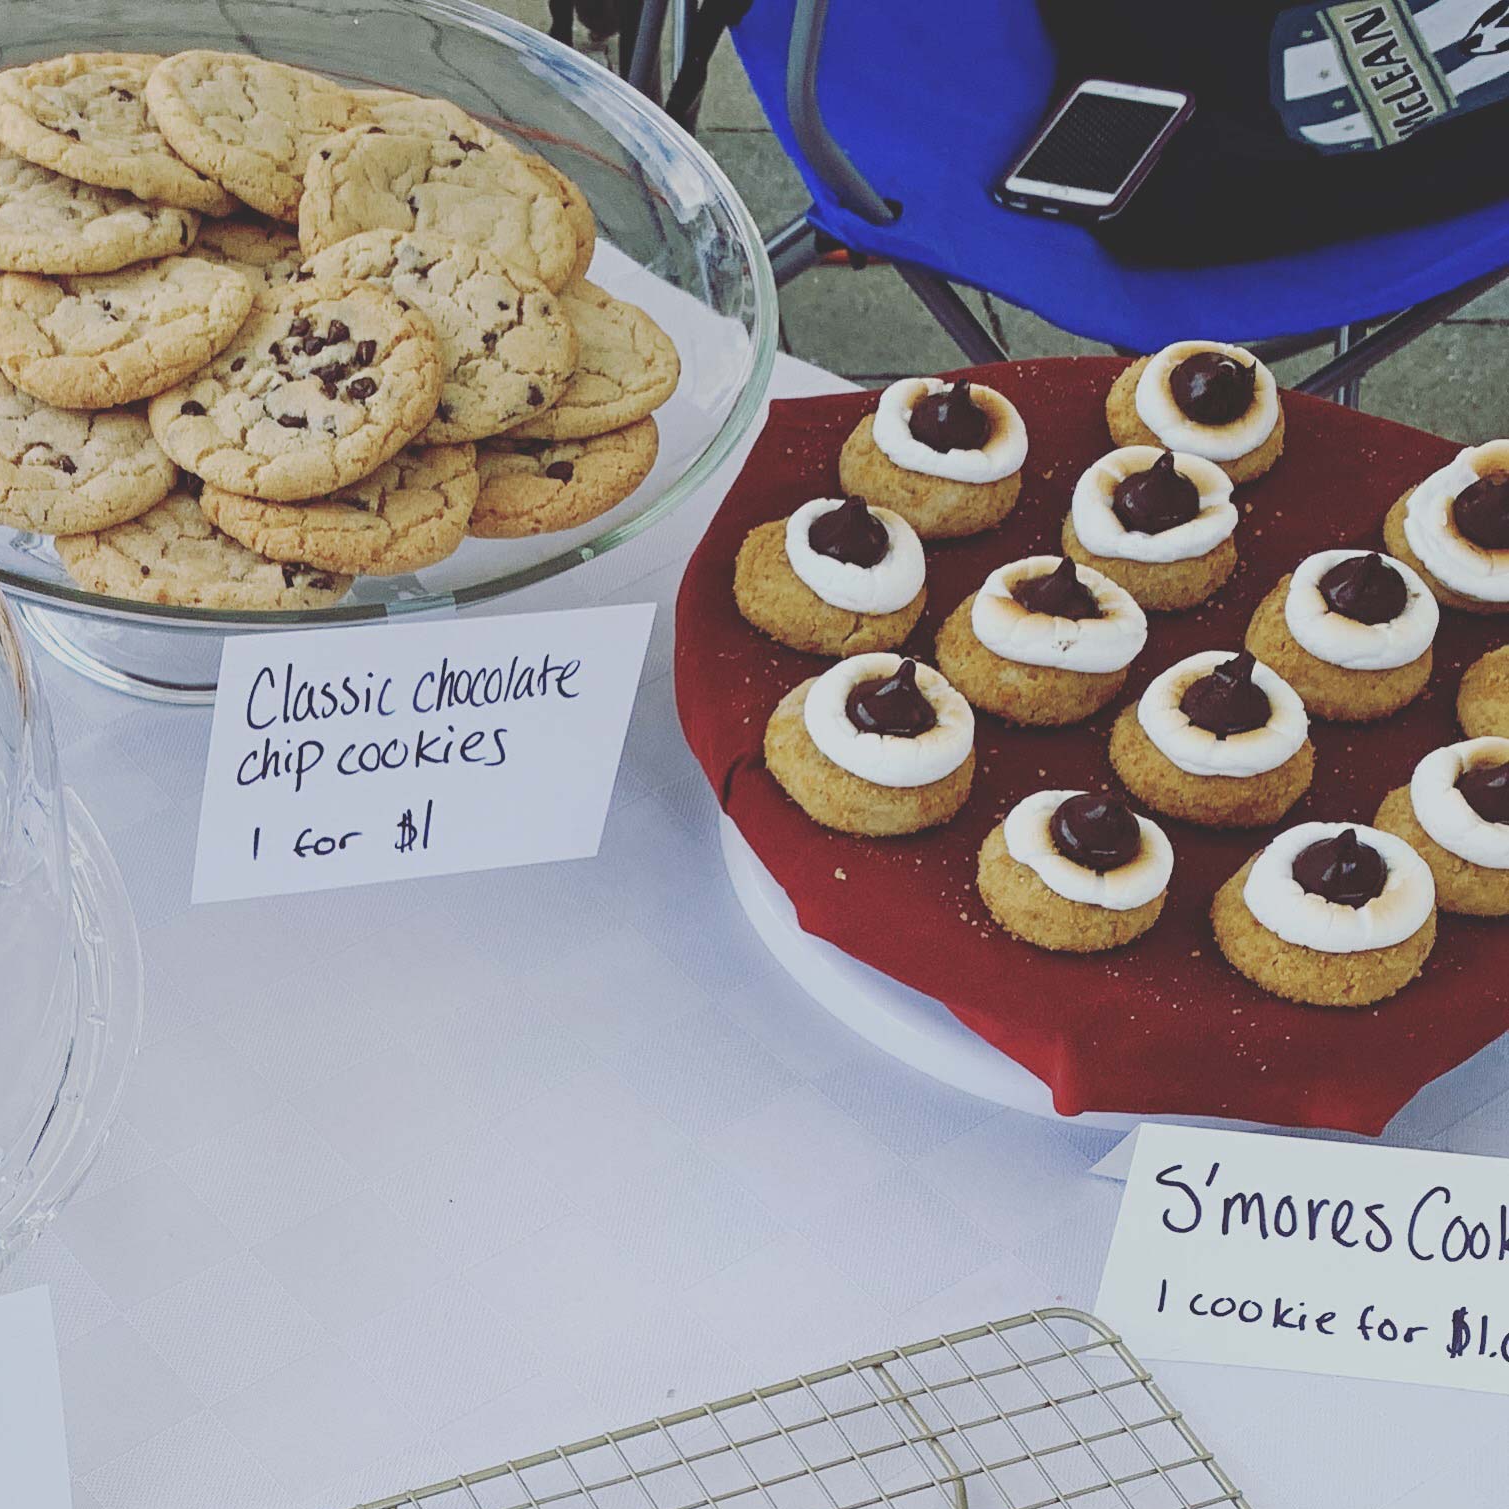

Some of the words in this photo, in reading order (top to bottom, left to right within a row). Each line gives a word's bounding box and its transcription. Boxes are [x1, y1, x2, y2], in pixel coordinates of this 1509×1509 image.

[246, 664, 395, 729] Classic
[236, 735, 325, 792] chip
[337, 725, 508, 776] cookies
[252, 827, 261, 860] 1
[293, 828, 363, 859] for
[394, 800, 434, 853] $1
[1155, 1162, 1393, 1253] S'mores
[1157, 1278, 1167, 1313] 1
[1189, 1293, 1337, 1335] cookie
[1358, 1305, 1429, 1344] for
